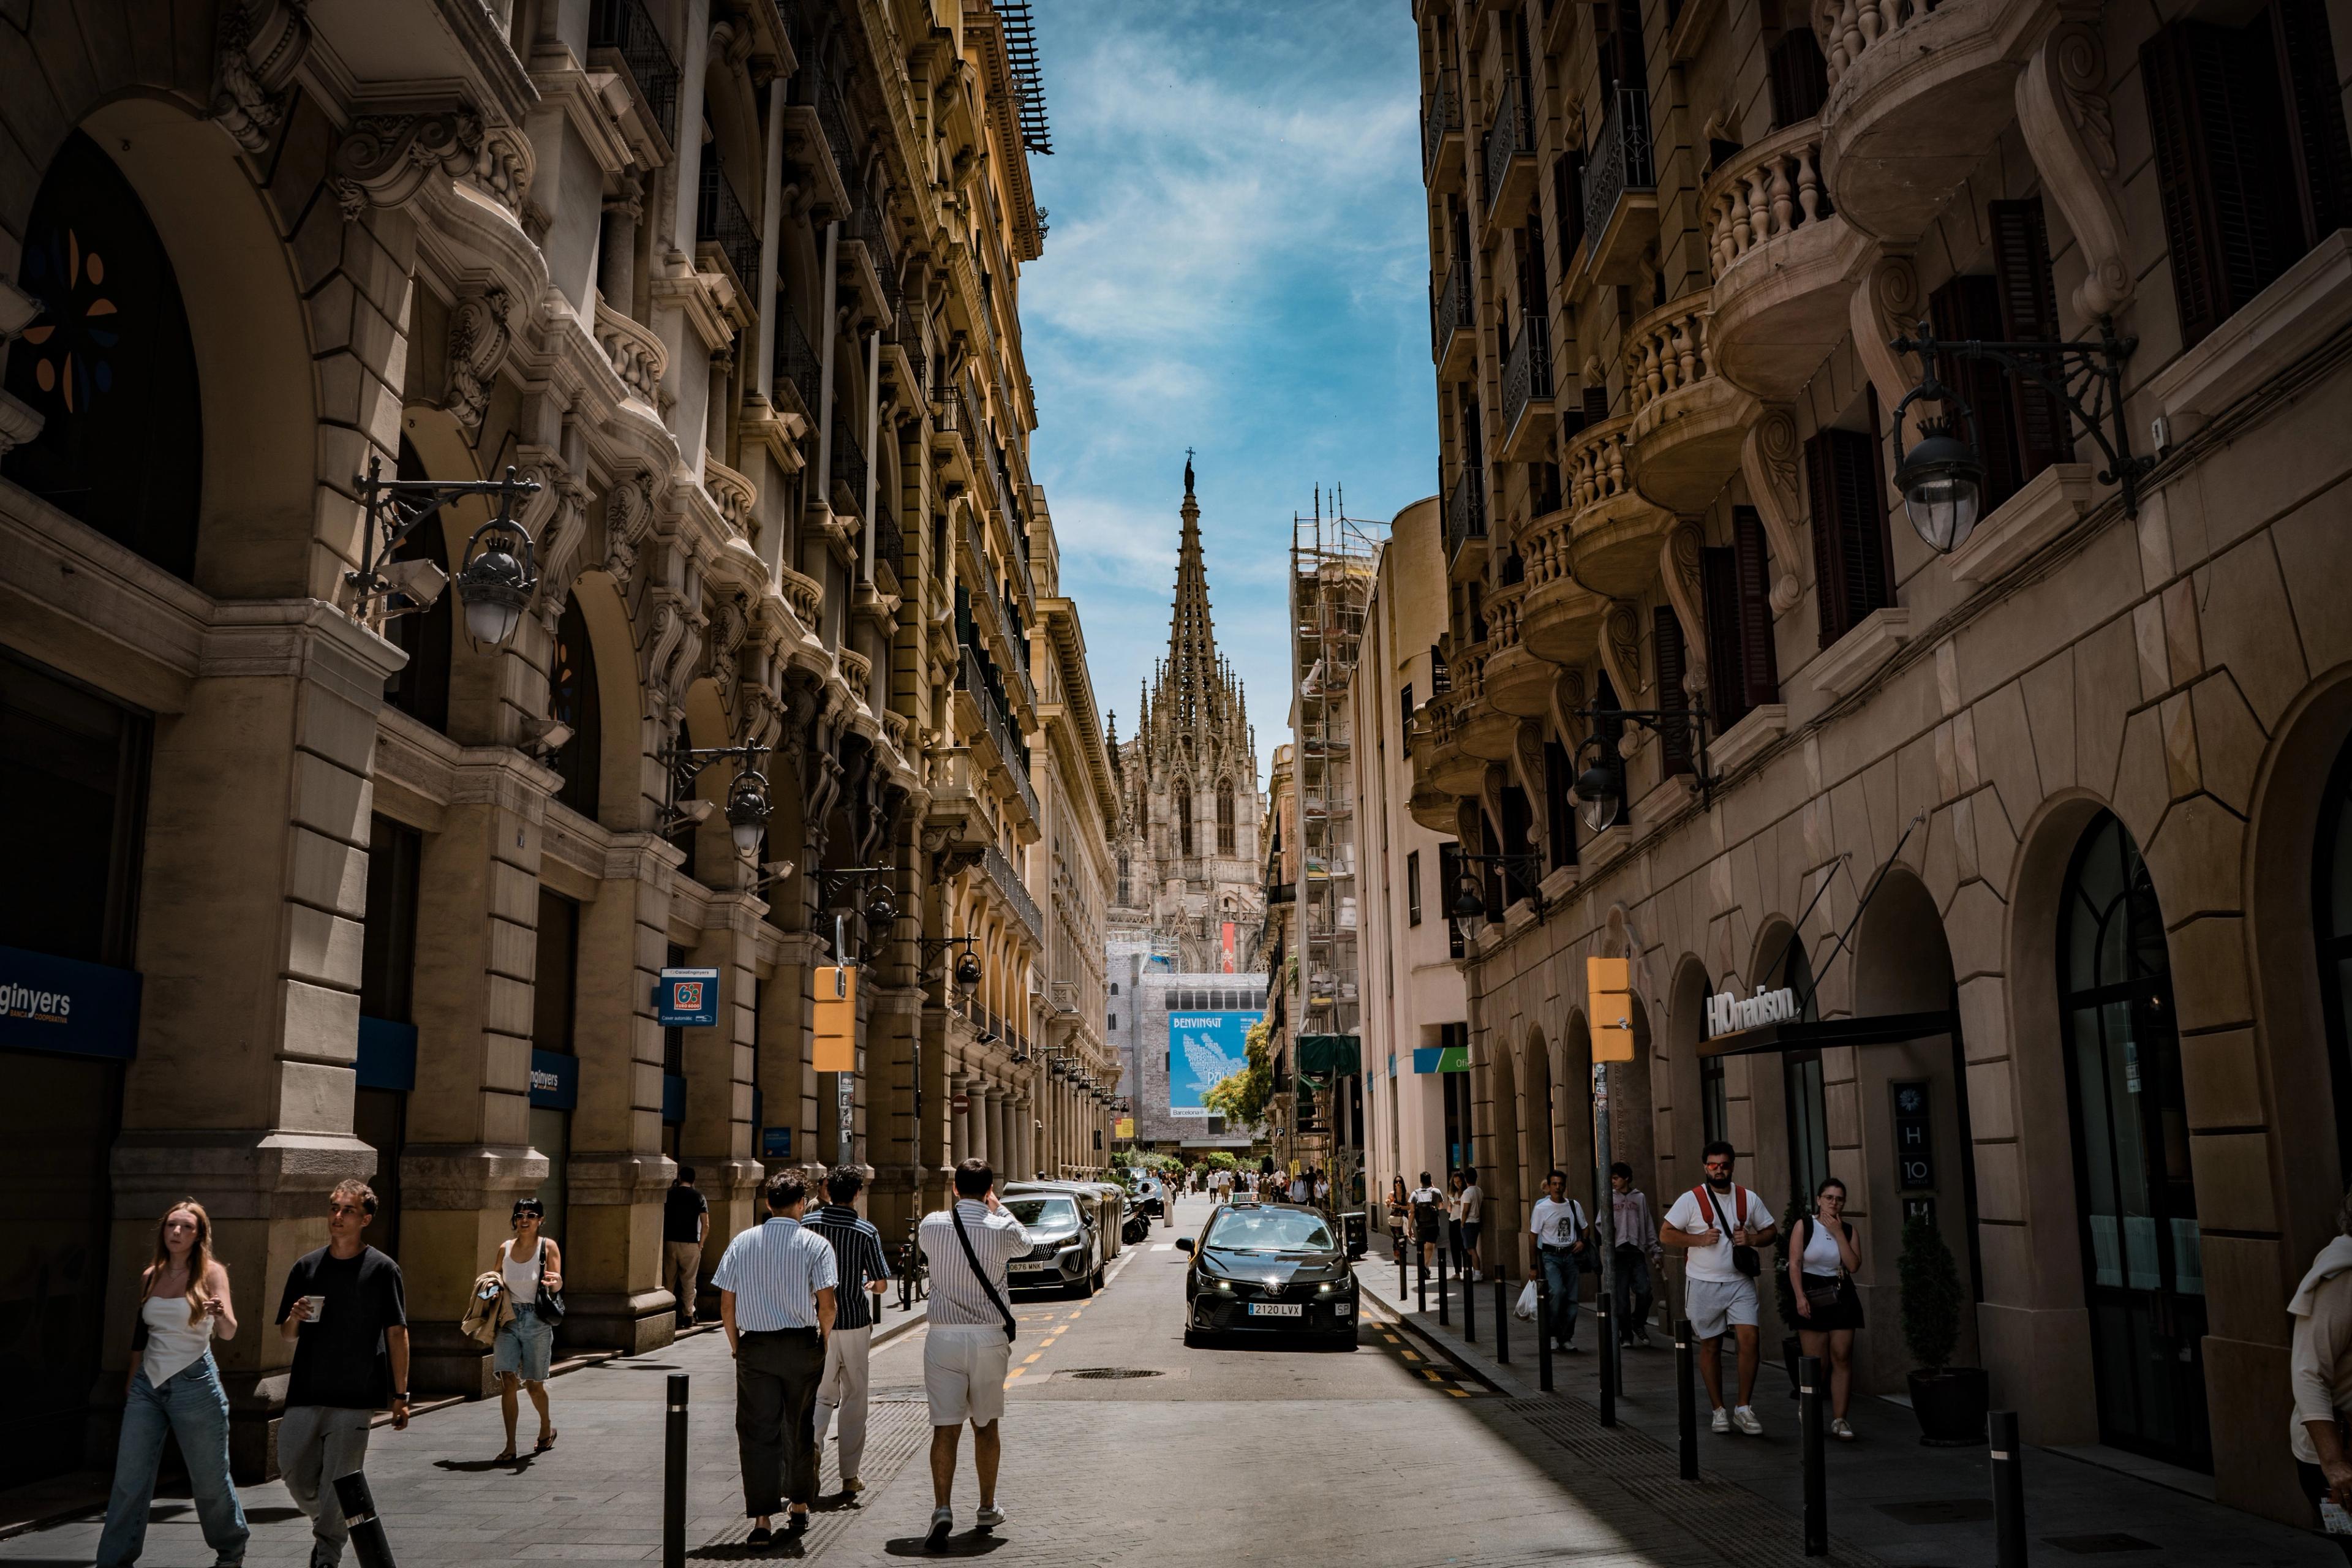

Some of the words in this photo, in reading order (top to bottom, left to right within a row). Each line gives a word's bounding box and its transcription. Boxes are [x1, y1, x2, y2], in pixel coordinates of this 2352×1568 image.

[0, 982, 70, 1018] ginyers
[34, 1014, 67, 1023] COOPERATIVA
[1174, 1018, 1222, 1028] BENVINGUT
[1906, 1127, 1921, 1144] H
[1904, 1161, 1928, 1178] 10
[1256, 1305, 1279, 1314] 2120
[1282, 1305, 1299, 1315] LVX
[1338, 1305, 1349, 1314] SP
